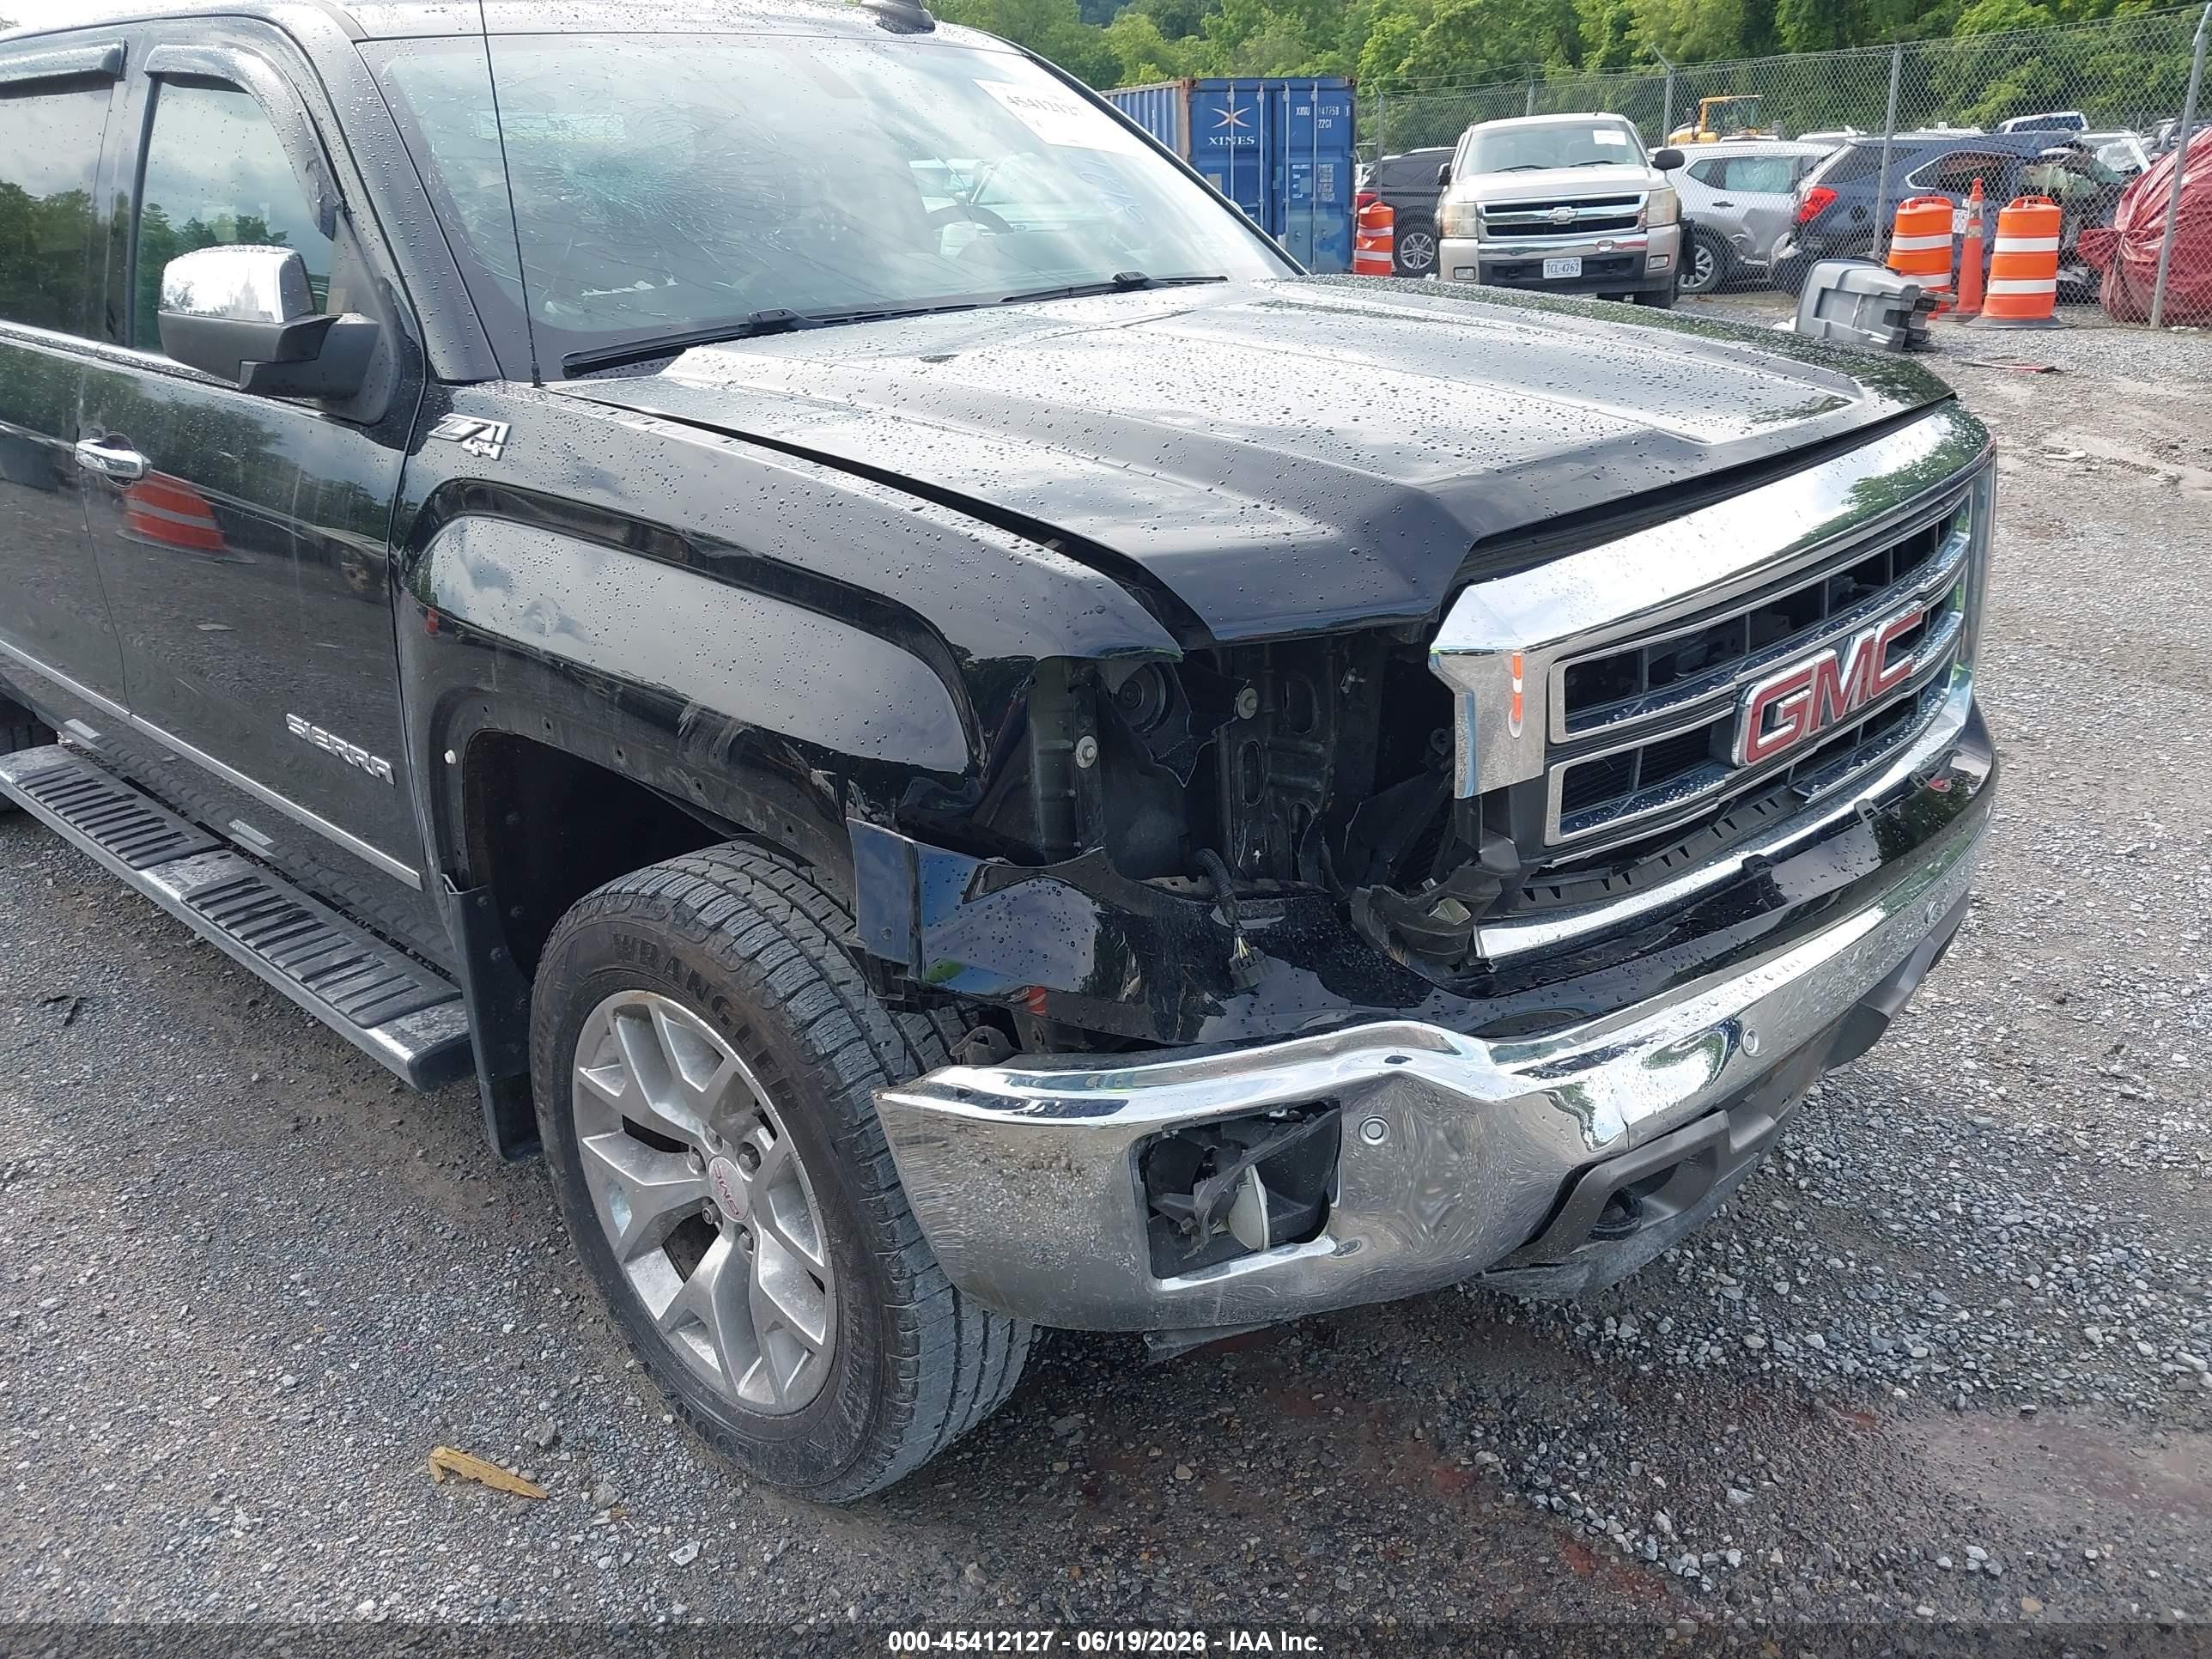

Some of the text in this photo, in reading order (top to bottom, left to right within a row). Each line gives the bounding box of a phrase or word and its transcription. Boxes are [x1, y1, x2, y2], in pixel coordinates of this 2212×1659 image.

[1208, 136, 1255, 145] XINES
[427, 413, 512, 445] Z71
[1734, 601, 1925, 766] GMC
[285, 713, 396, 786] SIERRA
[611, 933, 801, 1113] WRANGLER
[713, 1162, 740, 1216] GMC
